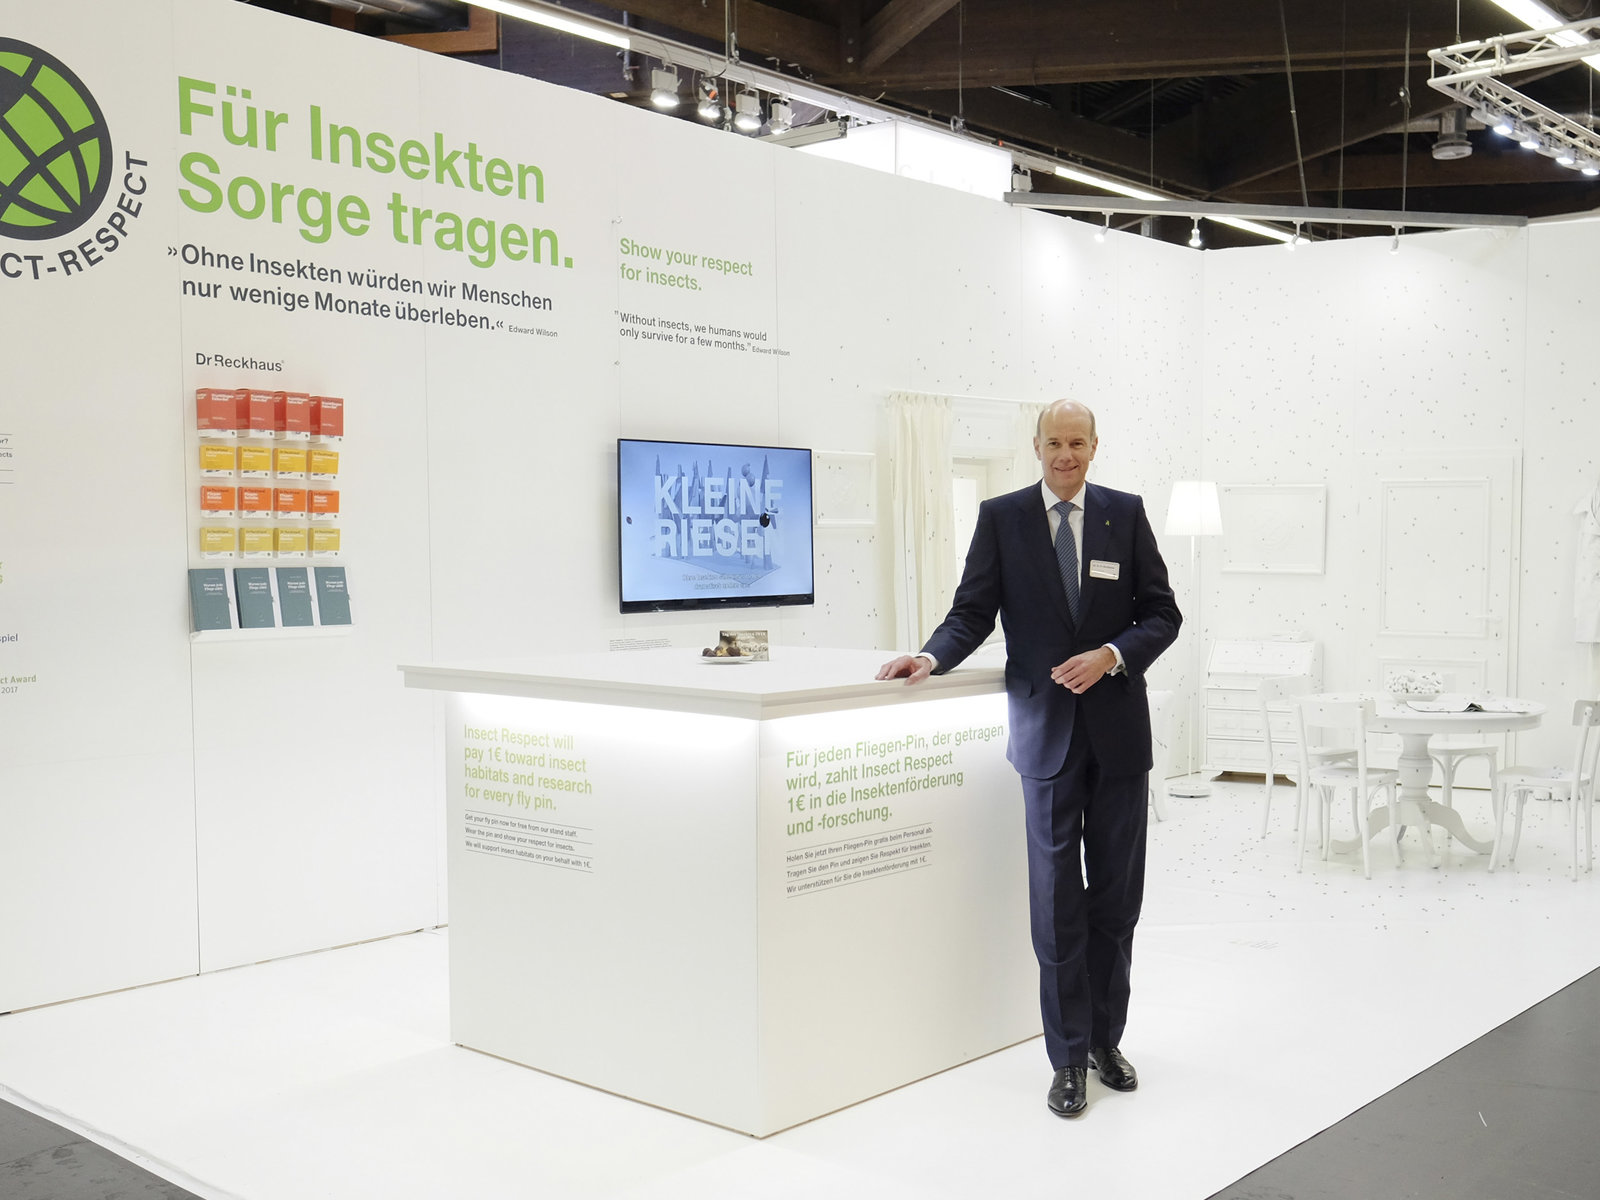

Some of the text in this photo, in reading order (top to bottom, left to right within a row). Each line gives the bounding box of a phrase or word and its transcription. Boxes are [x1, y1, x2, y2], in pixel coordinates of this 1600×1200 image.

[178, 76, 544, 203] Für Insekten
[178, 152, 573, 268] Sorge tragen.
[620, 237, 753, 276] Show your respect
[250, 253, 341, 285] Insekten
[347, 264, 423, 295] würden
[427, 277, 456, 299] wir
[462, 281, 552, 311] Menschen
[620, 263, 702, 291] for insects.
[182, 279, 221, 299] nur
[230, 282, 309, 311] wenige
[314, 291, 391, 319] Monate
[508, 325, 558, 338] Edward Wilson
[620, 327, 639, 340] only
[642, 331, 673, 342] survive
[675, 334, 688, 344] for
[697, 336, 712, 347] few
[658, 317, 692, 332] insects,
[694, 324, 706, 333] we
[708, 325, 741, 338] humans
[743, 330, 767, 341] would
[1, 686, 18, 694] 2017
[10, 675, 37, 683] Award
[464, 724, 574, 750] Insect Respect will
[786, 724, 1004, 768] Für jeden Fliegen-Pin, der getragen
[465, 747, 587, 773] pay 1€ toward insect
[786, 750, 953, 790] wird, zahlt Insect Respect
[465, 764, 592, 794] habitats and research
[788, 770, 964, 812] 1€ in die Insektenförderung
[465, 783, 557, 811] for every fly pin.
[465, 814, 473, 822] Get
[474, 816, 484, 824] your
[528, 823, 539, 831] from
[477, 828, 485, 836] the
[494, 831, 503, 839] and
[504, 833, 516, 841] show
[787, 805, 892, 836] und -forschung.
[482, 844, 500, 852] support
[501, 847, 515, 855] insect
[515, 849, 535, 859] habitats
[571, 858, 582, 866] with
[786, 854, 803, 863] Holen
[804, 852, 814, 860] Sie
[815, 848, 827, 858] jetzt
[843, 840, 873, 852] Fliegen-Pin
[890, 834, 902, 842] beim
[903, 828, 925, 839] Personal
[787, 869, 807, 880] Tragen
[808, 866, 817, 874] Sie
[818, 863, 829, 871] den
[830, 861, 839, 869] Pin
[840, 858, 850, 866] und
[851, 854, 869, 865] zeigen
[870, 852, 879, 861] Sie
[880, 848, 901, 860] Respekt
[787, 885, 797, 893] Wir
[798, 877, 833, 892] unterstützen
[834, 875, 842, 883] für
[843, 873, 852, 881] Sie
[853, 871, 861, 879] die
[862, 860, 909, 876] Insektenförderung
